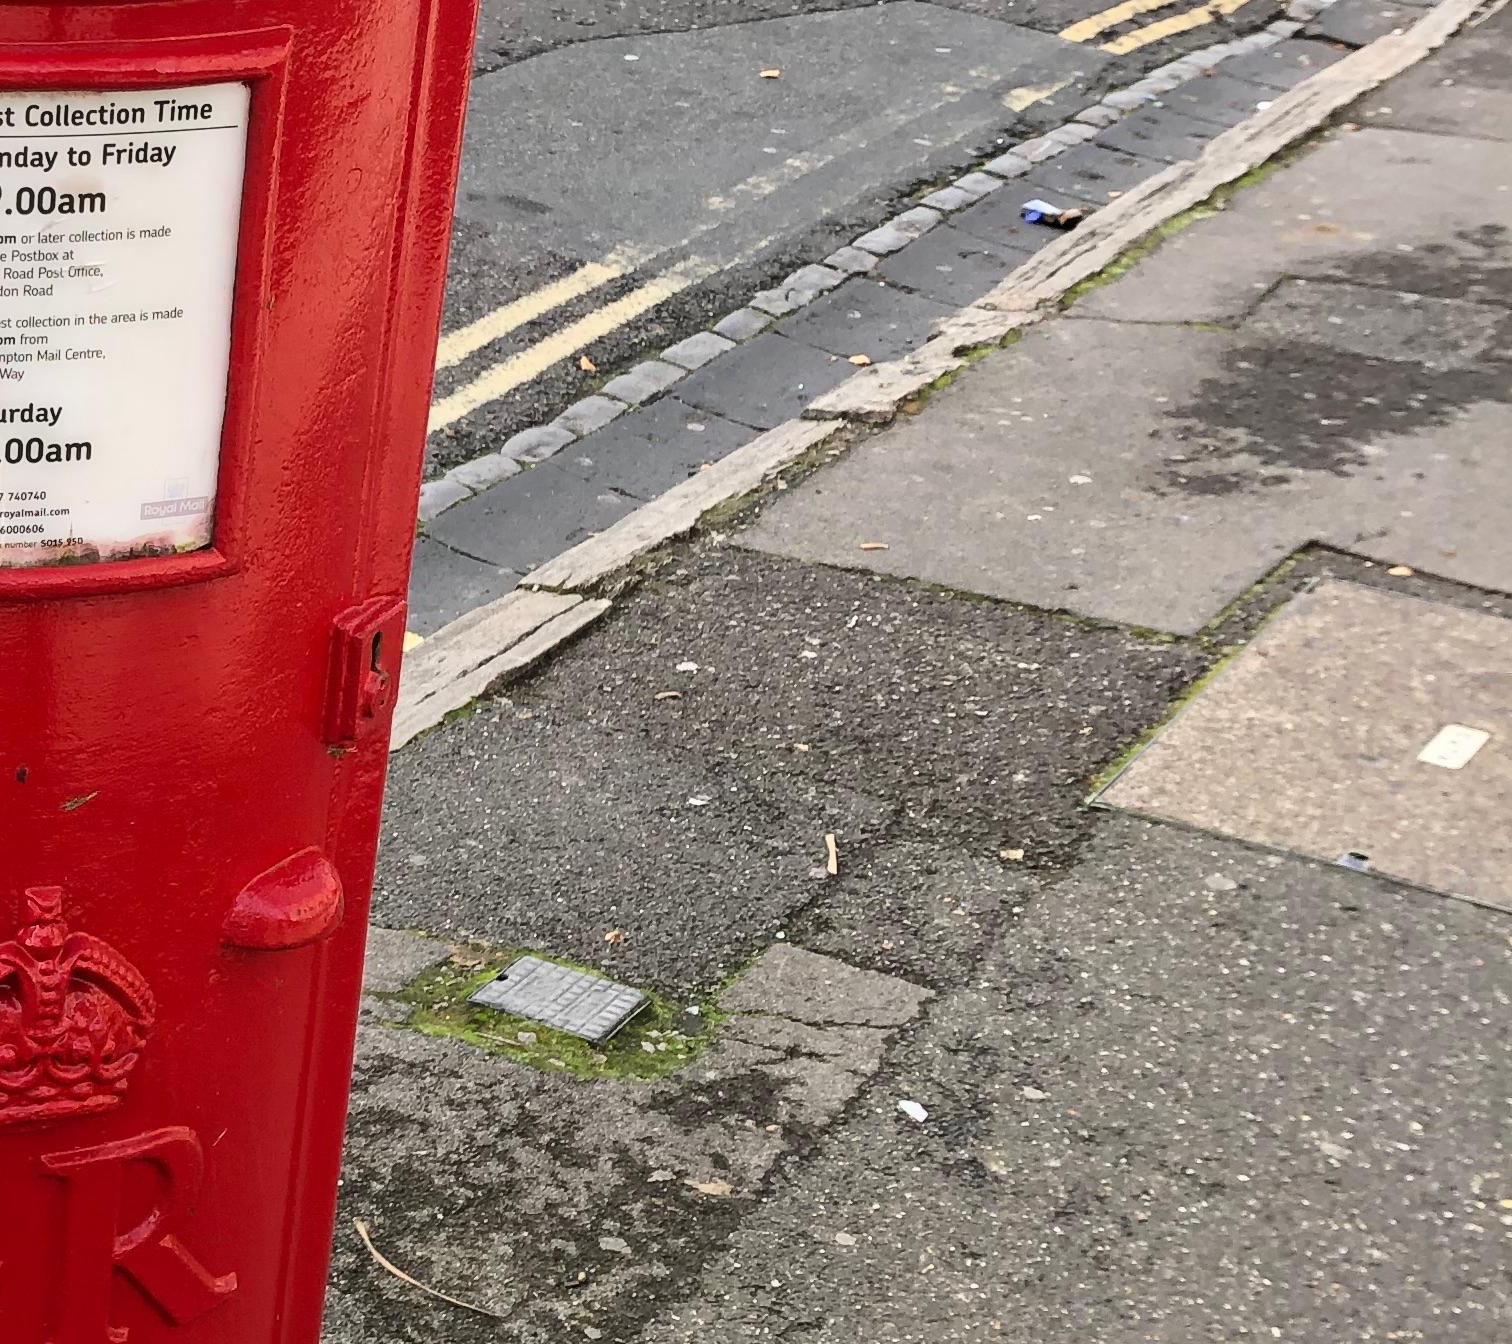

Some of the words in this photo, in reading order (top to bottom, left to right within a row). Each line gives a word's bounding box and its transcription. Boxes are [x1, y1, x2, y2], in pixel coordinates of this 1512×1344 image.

[25, 103, 145, 127] Collection
[154, 100, 212, 123] Time
[68, 145, 91, 166] to
[102, 143, 176, 167] Friday
[21, 235, 34, 244] or
[38, 232, 65, 244] later
[69, 229, 123, 243] collection
[126, 228, 135, 239] is
[139, 225, 171, 238] made
[11, 250, 58, 262] Postbox
[62, 250, 74, 261] at
[3, 267, 34, 279] Road
[38, 267, 64, 278] Post
[23, 284, 53, 296] Road
[16, 316, 70, 328] collection
[74, 315, 84, 326] in
[89, 314, 107, 325] the
[111, 312, 136, 324] area
[139, 309, 148, 322] is
[152, 307, 183, 321] made
[20, 334, 48, 345] from
[37, 349, 61, 361] Mail
[0, 368, 24, 381] Way
[8, 491, 46, 501] 740740
[144, 503, 177, 516] Royal
[179, 499, 204, 512] Mail
[0, 524, 44, 534] 6000606
[5, 541, 37, 549] number
